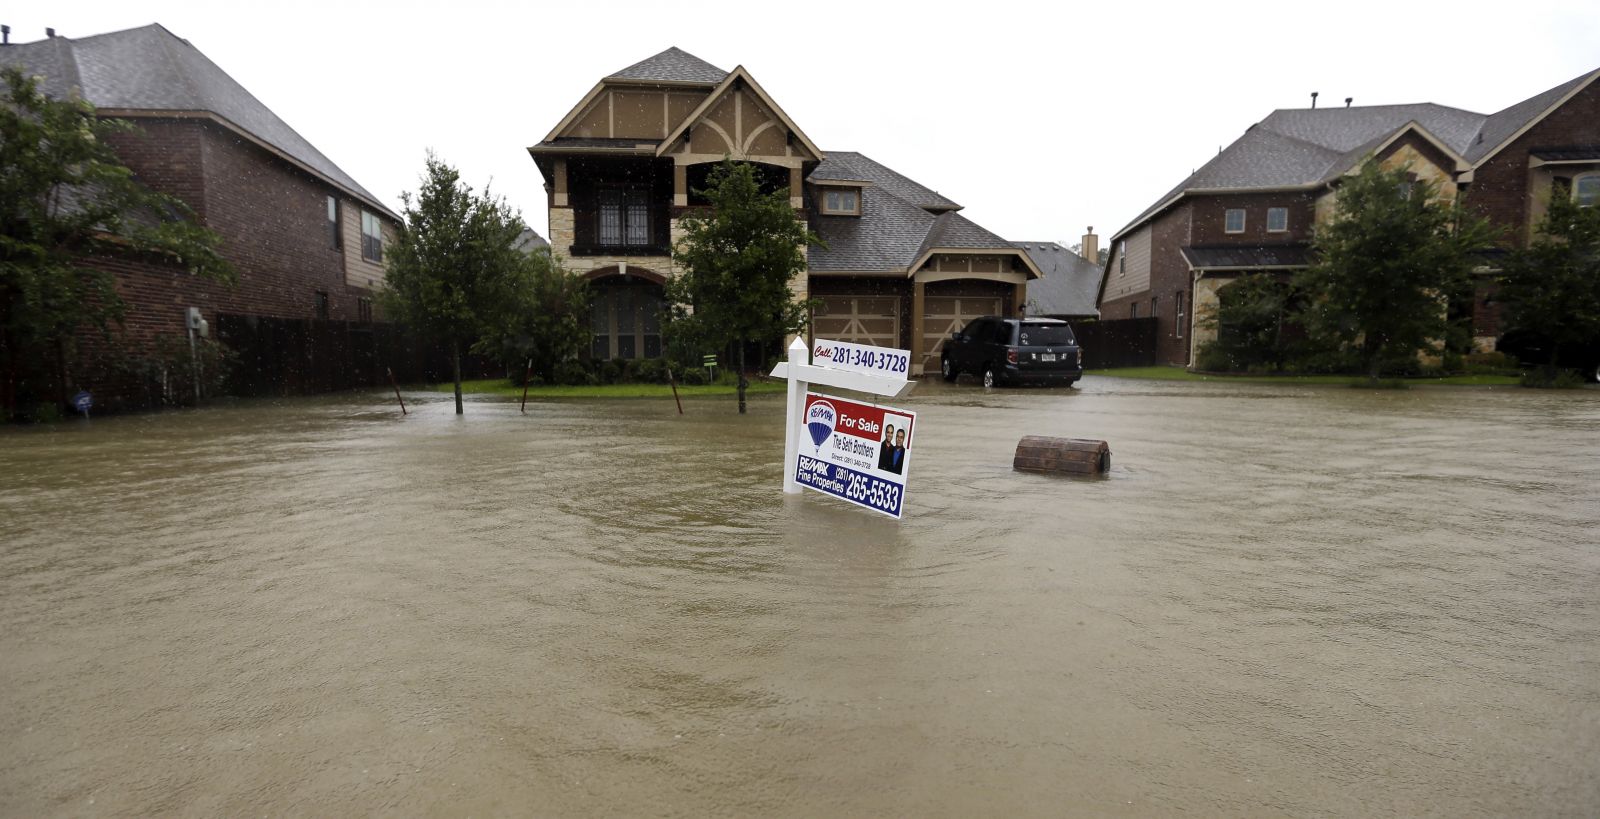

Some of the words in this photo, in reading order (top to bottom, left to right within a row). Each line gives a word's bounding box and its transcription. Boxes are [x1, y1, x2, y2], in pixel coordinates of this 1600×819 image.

[814, 346, 832, 358] Call:
[832, 347, 907, 373] 281-340-3728
[810, 407, 834, 423] RE/MAX
[840, 414, 855, 428] For
[858, 418, 879, 434] Sale
[833, 435, 842, 449] The
[842, 437, 853, 452] Seth
[853, 439, 874, 458] Brothers
[799, 456, 829, 476] RE/MAX
[854, 458, 872, 469] 340-3728
[798, 468, 811, 482] Fine
[812, 473, 844, 494] Properties
[835, 467, 849, 481] (281)
[846, 472, 899, 512] 265-5533
